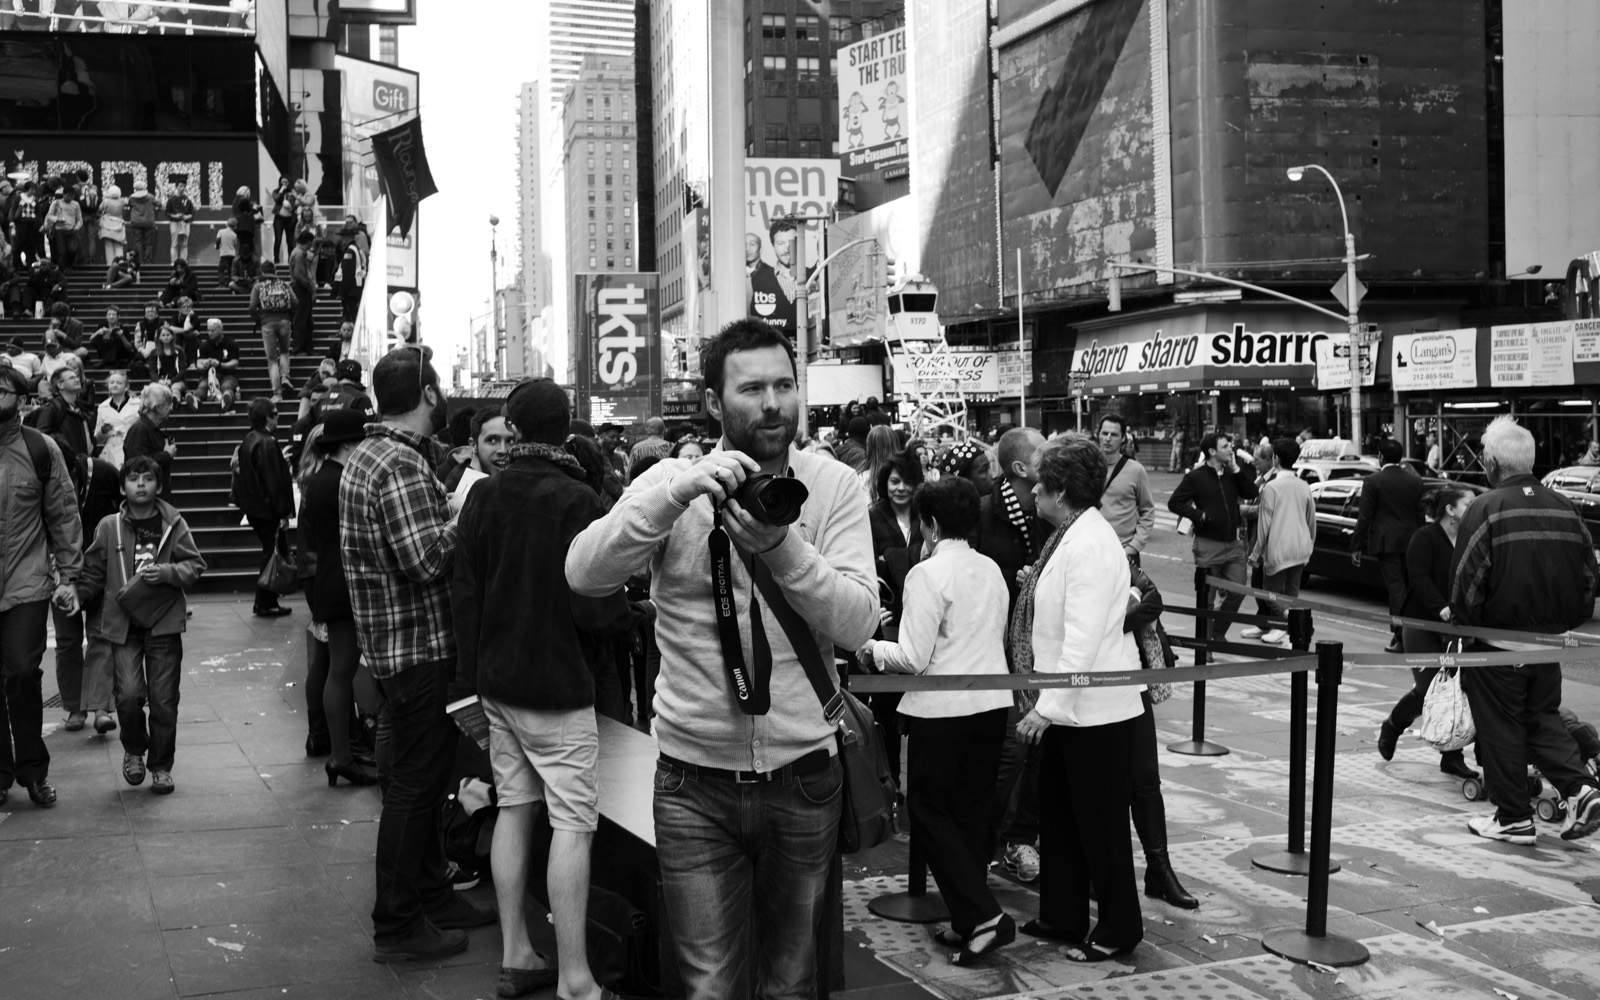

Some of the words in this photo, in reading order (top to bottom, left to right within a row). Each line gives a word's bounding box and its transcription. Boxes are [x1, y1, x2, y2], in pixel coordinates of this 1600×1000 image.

[849, 37, 885, 67] START
[858, 62, 880, 86] THE
[375, 86, 405, 110] Gift
[745, 166, 826, 197] men
[754, 291, 776, 304] tbs
[910, 317, 927, 325] NYPD
[1575, 321, 1600, 332] DANGER
[598, 283, 647, 385] tkts
[1211, 326, 1329, 364] sbarro
[906, 356, 945, 369] GONG
[972, 355, 993, 367] OF
[1078, 341, 1129, 375] sbarro
[1139, 332, 1199, 371] sbarro
[1415, 343, 1452, 359] Langan's
[682, 404, 699, 412] LINE
[717, 557, 727, 594] DIGITAL
[721, 596, 731, 617] EOS
[1439, 654, 1455, 666] tkts
[733, 668, 749, 701] Canon
[1071, 674, 1090, 686] tkts
